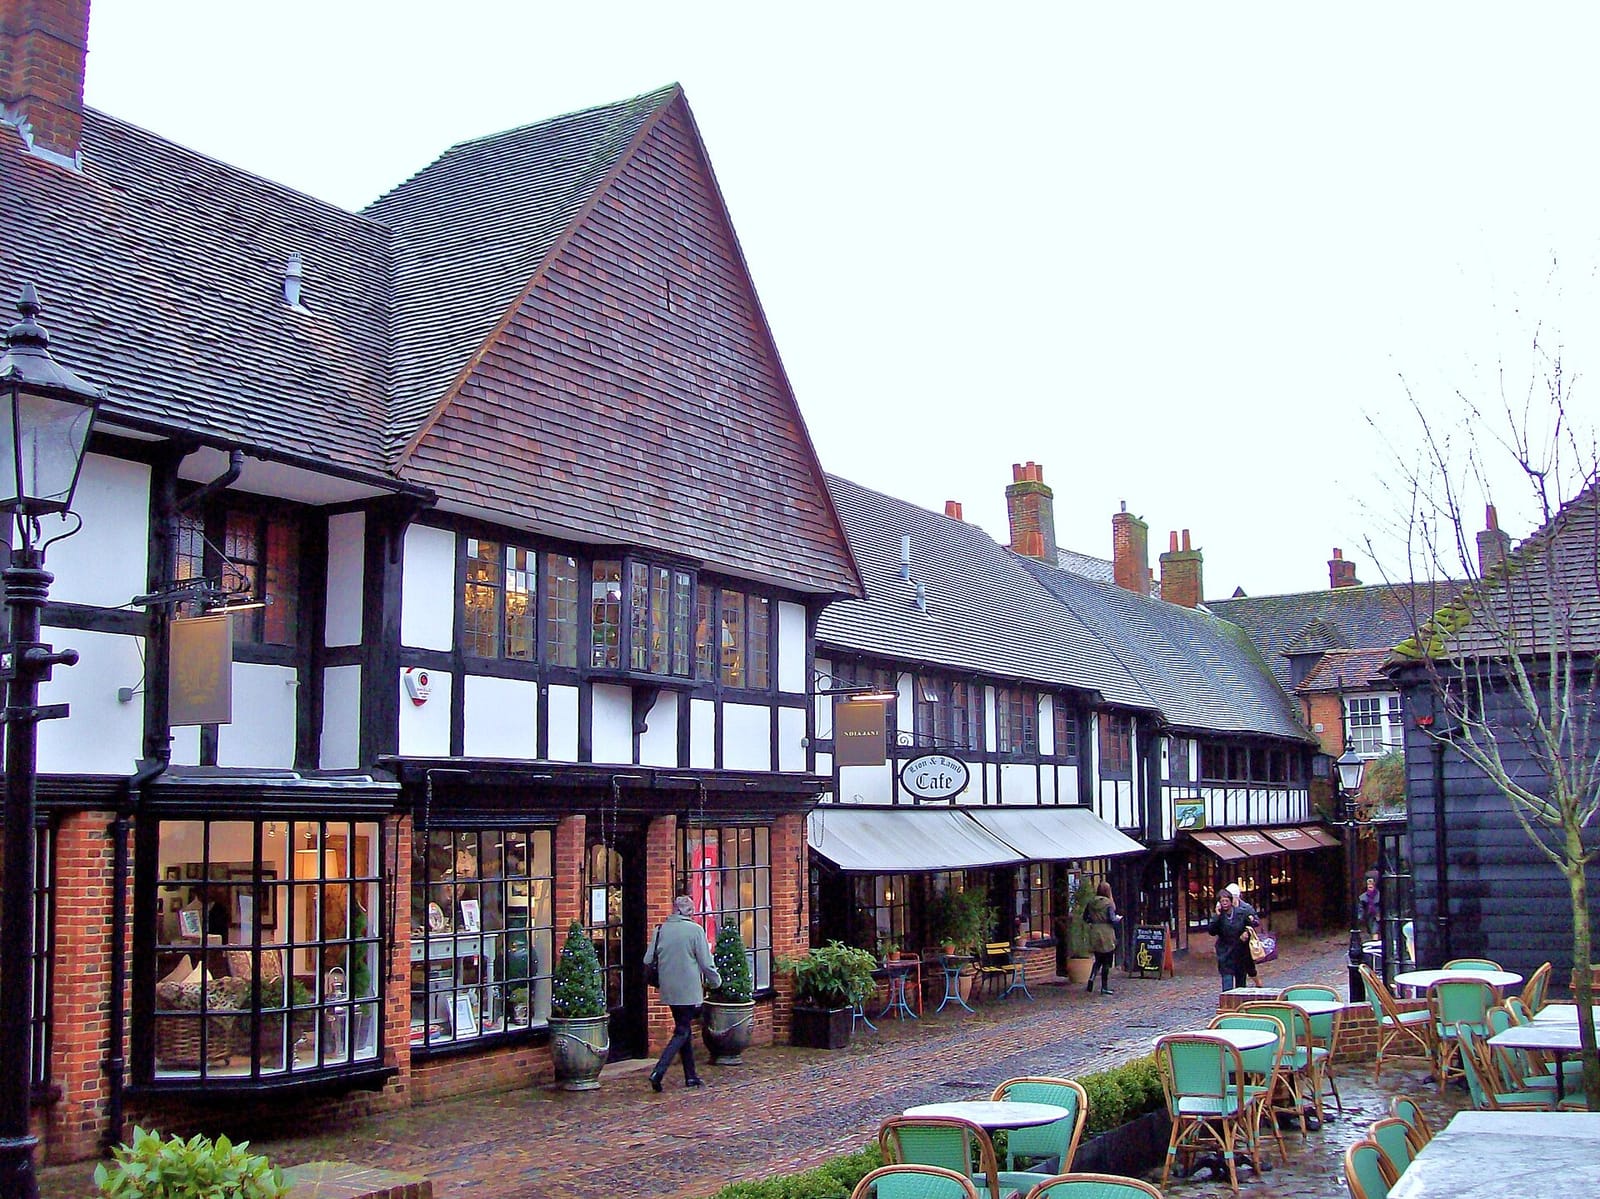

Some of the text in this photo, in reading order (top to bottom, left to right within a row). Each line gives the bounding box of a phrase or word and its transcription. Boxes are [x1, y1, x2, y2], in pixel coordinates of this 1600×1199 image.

[908, 757, 963, 774] Lion & Lamb
[915, 772, 953, 790] Cafe
